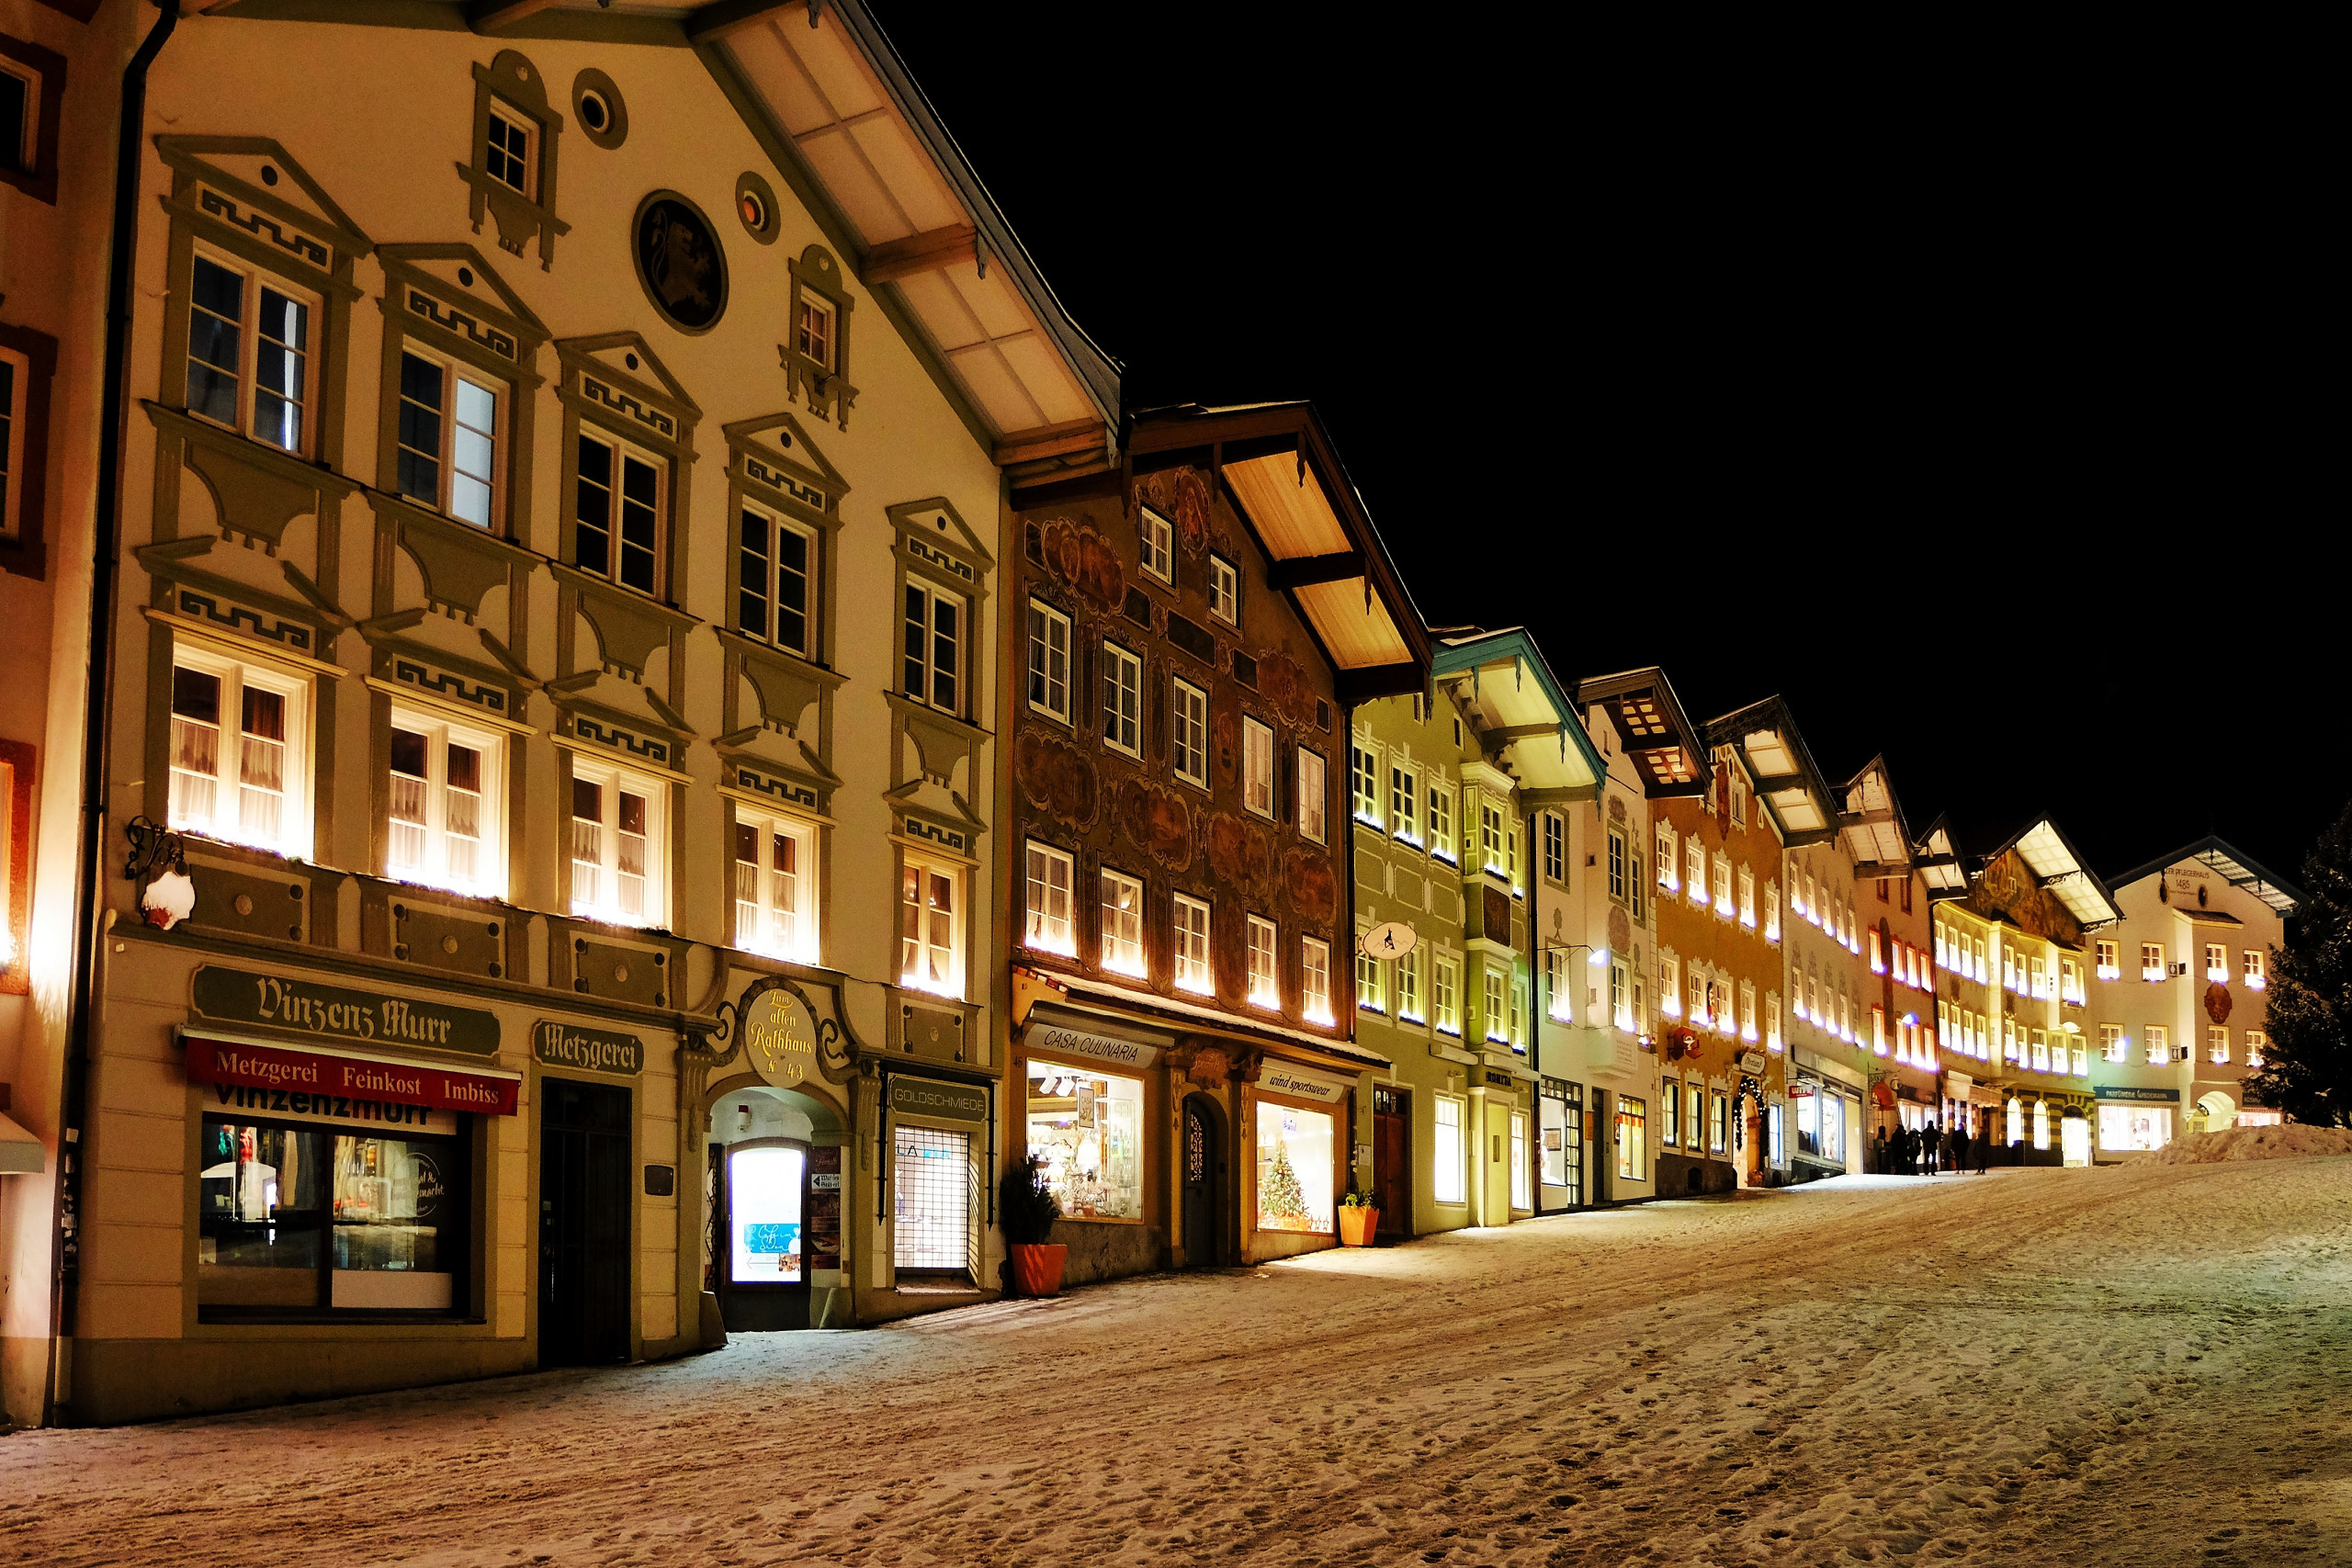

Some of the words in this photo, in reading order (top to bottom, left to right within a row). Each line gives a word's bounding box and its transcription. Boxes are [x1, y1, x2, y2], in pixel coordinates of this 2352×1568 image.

[256, 977, 374, 1039] Vinzenz
[382, 1000, 451, 1044] Murr
[770, 1008, 797, 1027] alten
[545, 1023, 636, 1069] Metzgerei
[751, 1021, 811, 1057] Rathhaus
[1044, 1030, 1078, 1050] CASA
[1080, 1037, 1138, 1063] CULINARIA
[217, 1051, 318, 1084] Metzgerei
[343, 1066, 422, 1095] Feinkost
[444, 1079, 499, 1104] Imbiss
[787, 1063, 803, 1079] 43
[1269, 1074, 1292, 1088] wind
[1288, 1079, 1330, 1097] sportswear
[894, 1089, 984, 1111] GOLDSCHMIEDE
[897, 1144, 917, 1157] LA
